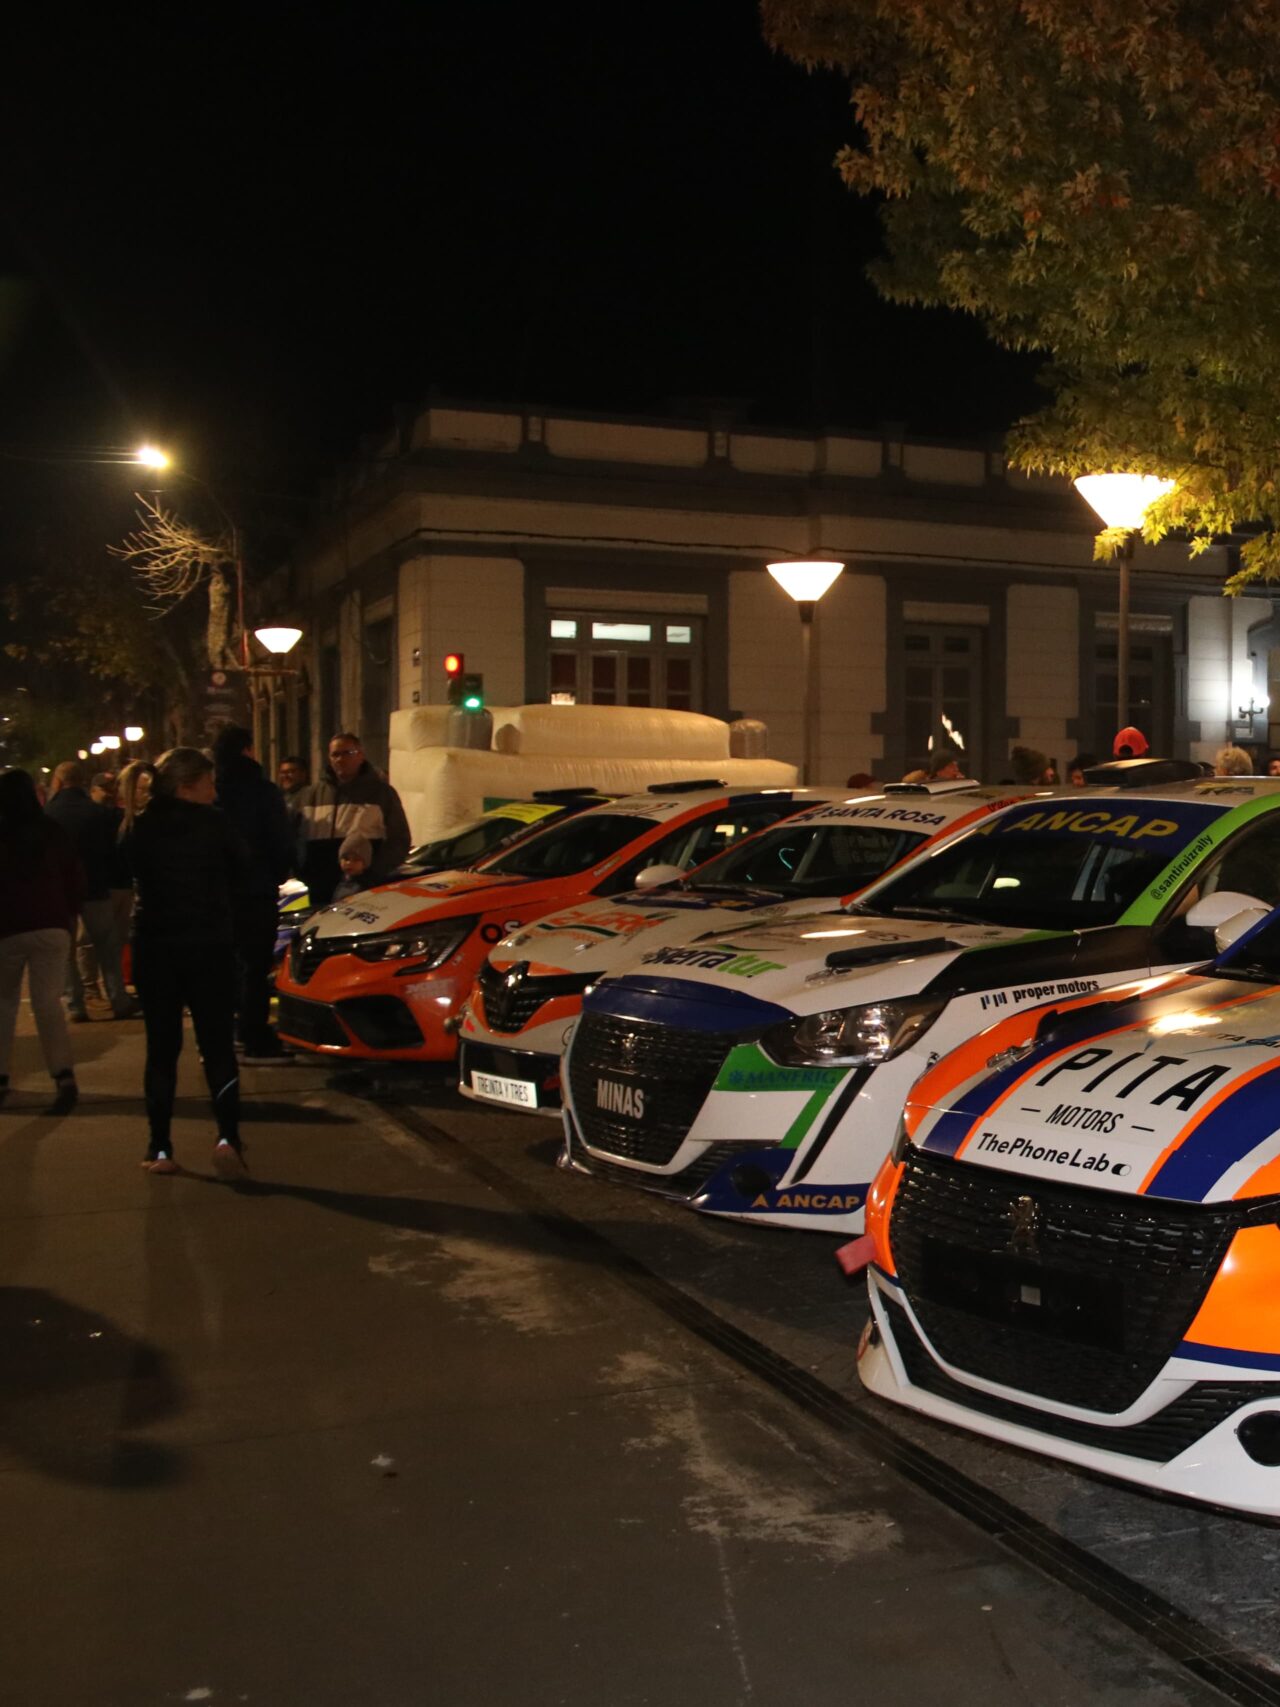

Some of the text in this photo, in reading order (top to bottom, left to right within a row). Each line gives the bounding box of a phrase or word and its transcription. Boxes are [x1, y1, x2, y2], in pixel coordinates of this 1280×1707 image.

[820, 807, 886, 820] SANTA
[884, 808, 947, 826] ROSA
[1003, 811, 1180, 840] ANCAP
[1150, 834, 1214, 900] @santiruizrally
[1012, 979, 1100, 1003] proper motors
[476, 1075, 504, 1097] TREINTA
[510, 1082, 529, 1103] TRES
[1034, 1047, 1232, 1112] PITA
[596, 1078, 645, 1120] MINAS
[1044, 1103, 1125, 1135] MOTORS
[775, 1193, 861, 1210] ANCAP
